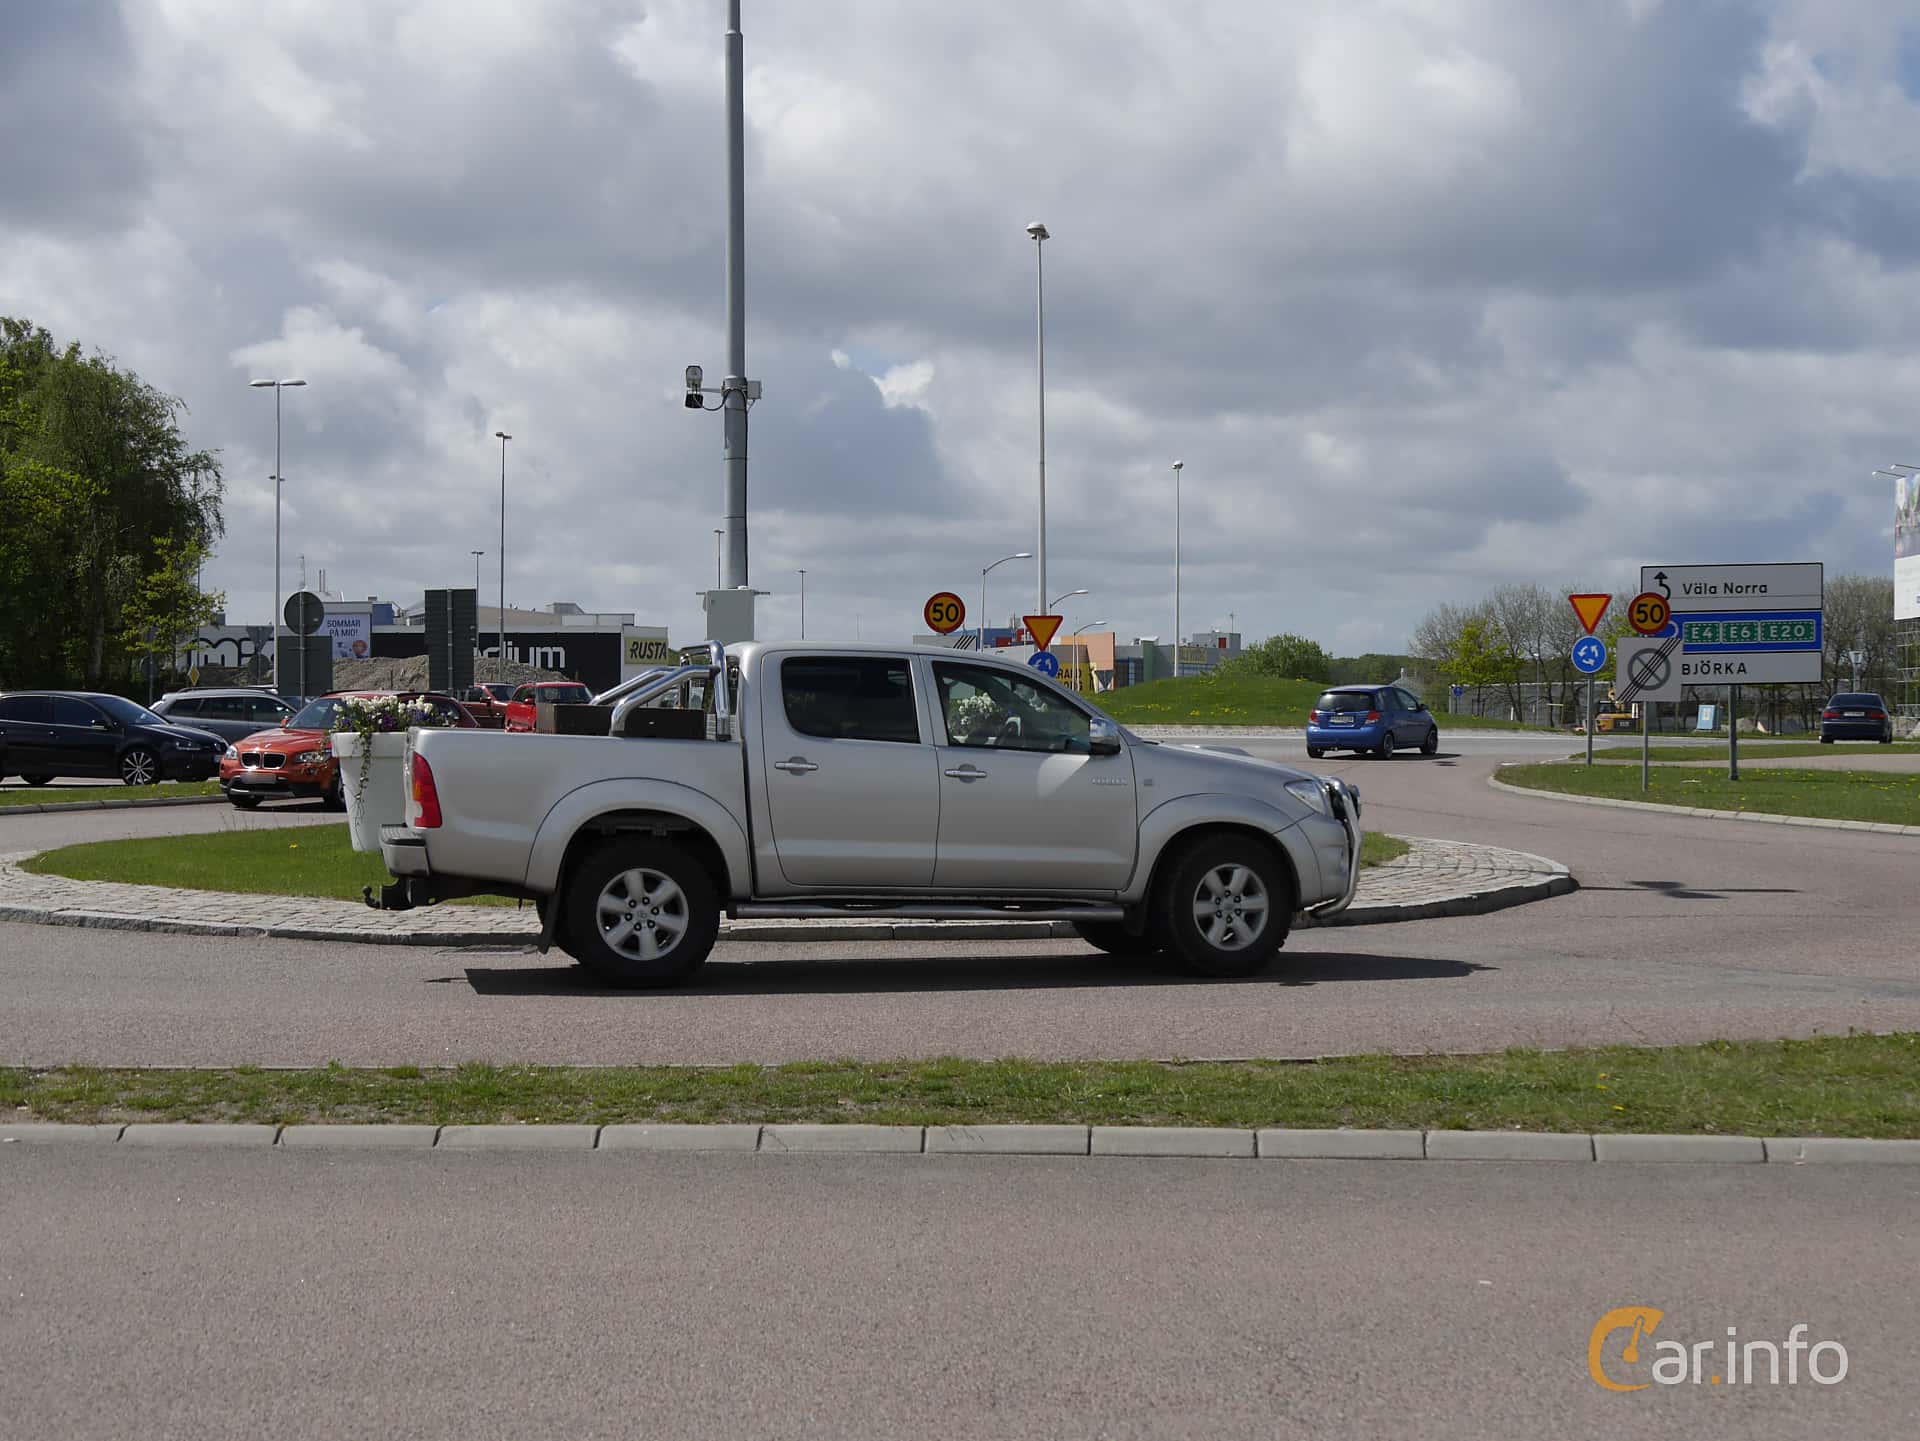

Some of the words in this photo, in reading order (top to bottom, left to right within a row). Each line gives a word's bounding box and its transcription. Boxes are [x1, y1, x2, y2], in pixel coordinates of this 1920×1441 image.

[1683, 583, 1717, 595] Väla
[1723, 582, 1768, 594] Norra
[932, 602, 960, 623] 50
[1636, 603, 1665, 624] 50
[327, 619, 361, 628] SOMMAR
[1691, 627, 1713, 639] E4
[1730, 626, 1750, 638] E6
[1769, 625, 1806, 638] E20
[630, 641, 667, 659] RUSTA
[1681, 660, 1748, 675] BJÖRKA
